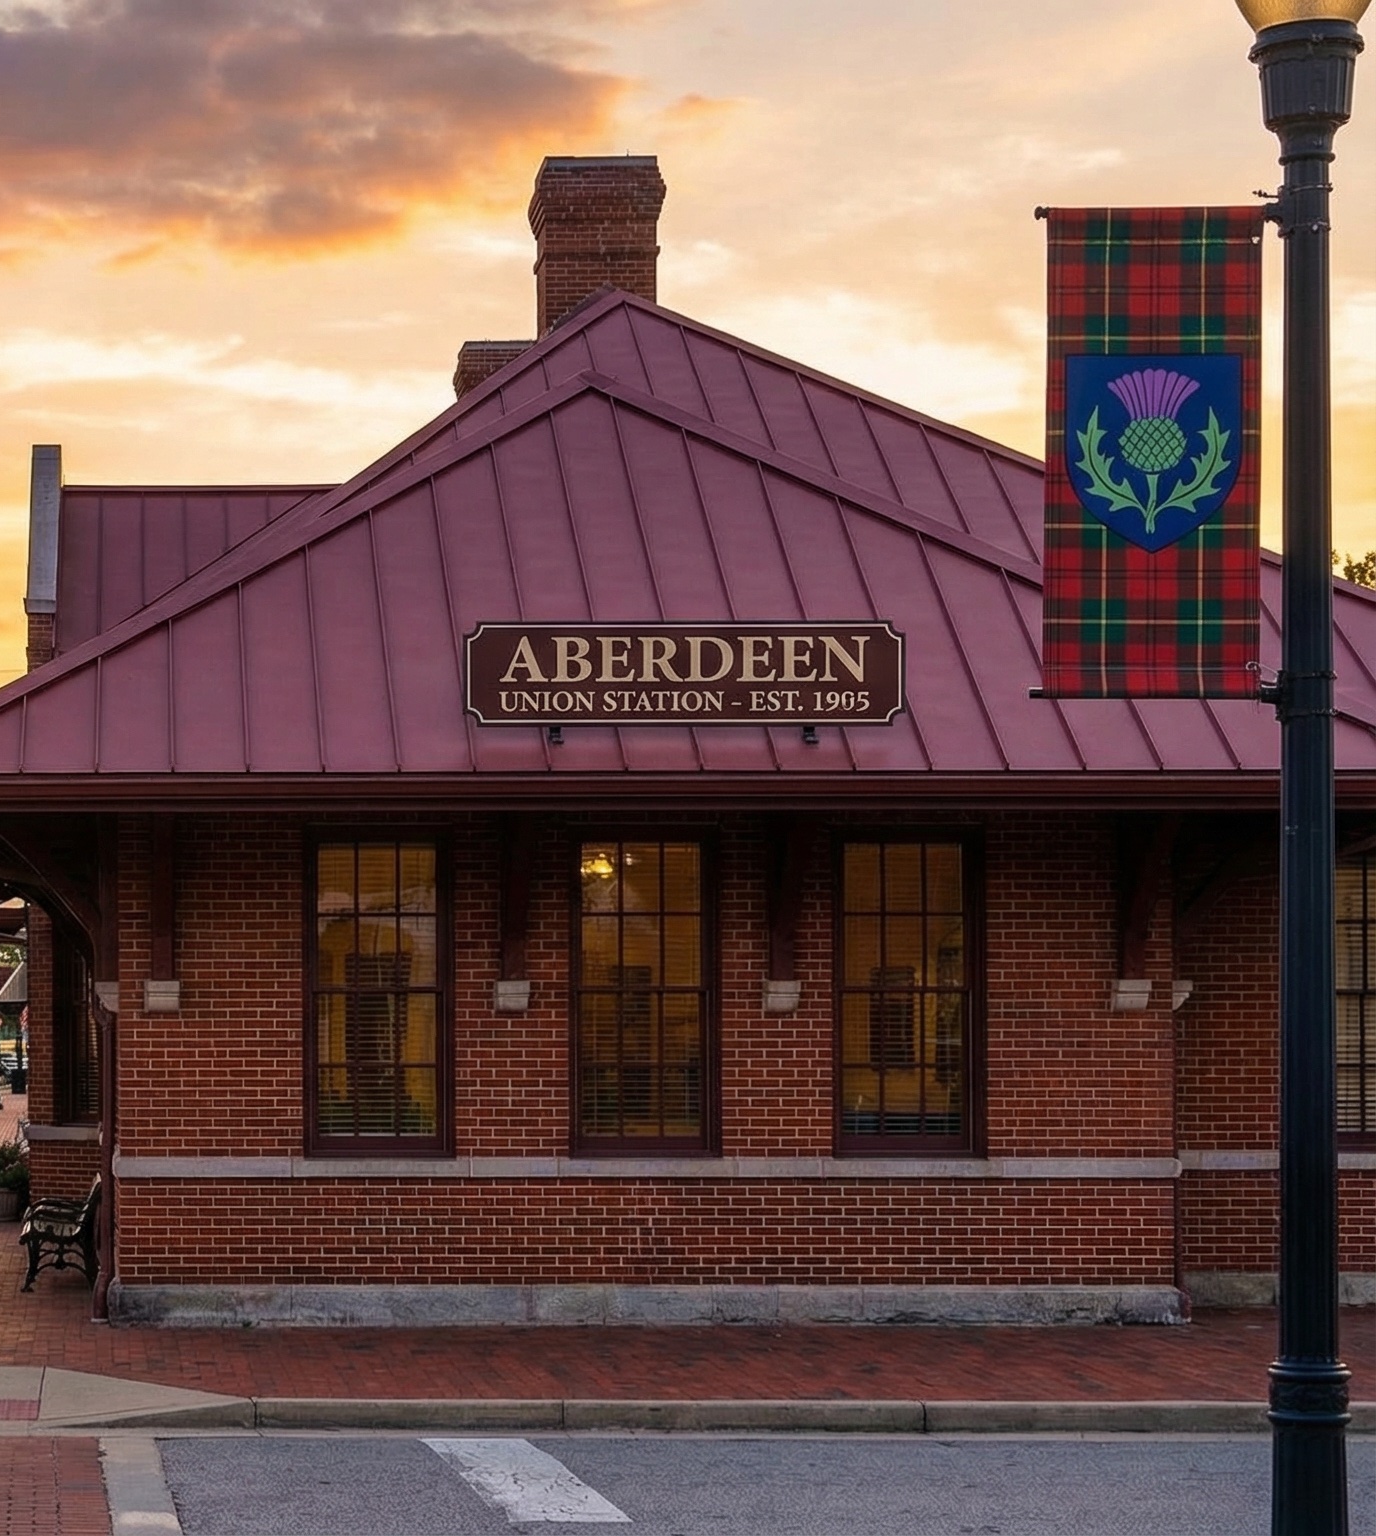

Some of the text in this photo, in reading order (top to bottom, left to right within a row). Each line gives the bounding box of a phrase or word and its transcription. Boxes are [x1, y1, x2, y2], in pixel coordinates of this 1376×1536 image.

[499, 635, 871, 683] ABERDEEN
[498, 690, 596, 712] UNION
[602, 690, 724, 712] STATION
[749, 690, 804, 712] EST.
[813, 691, 870, 712] 1905
